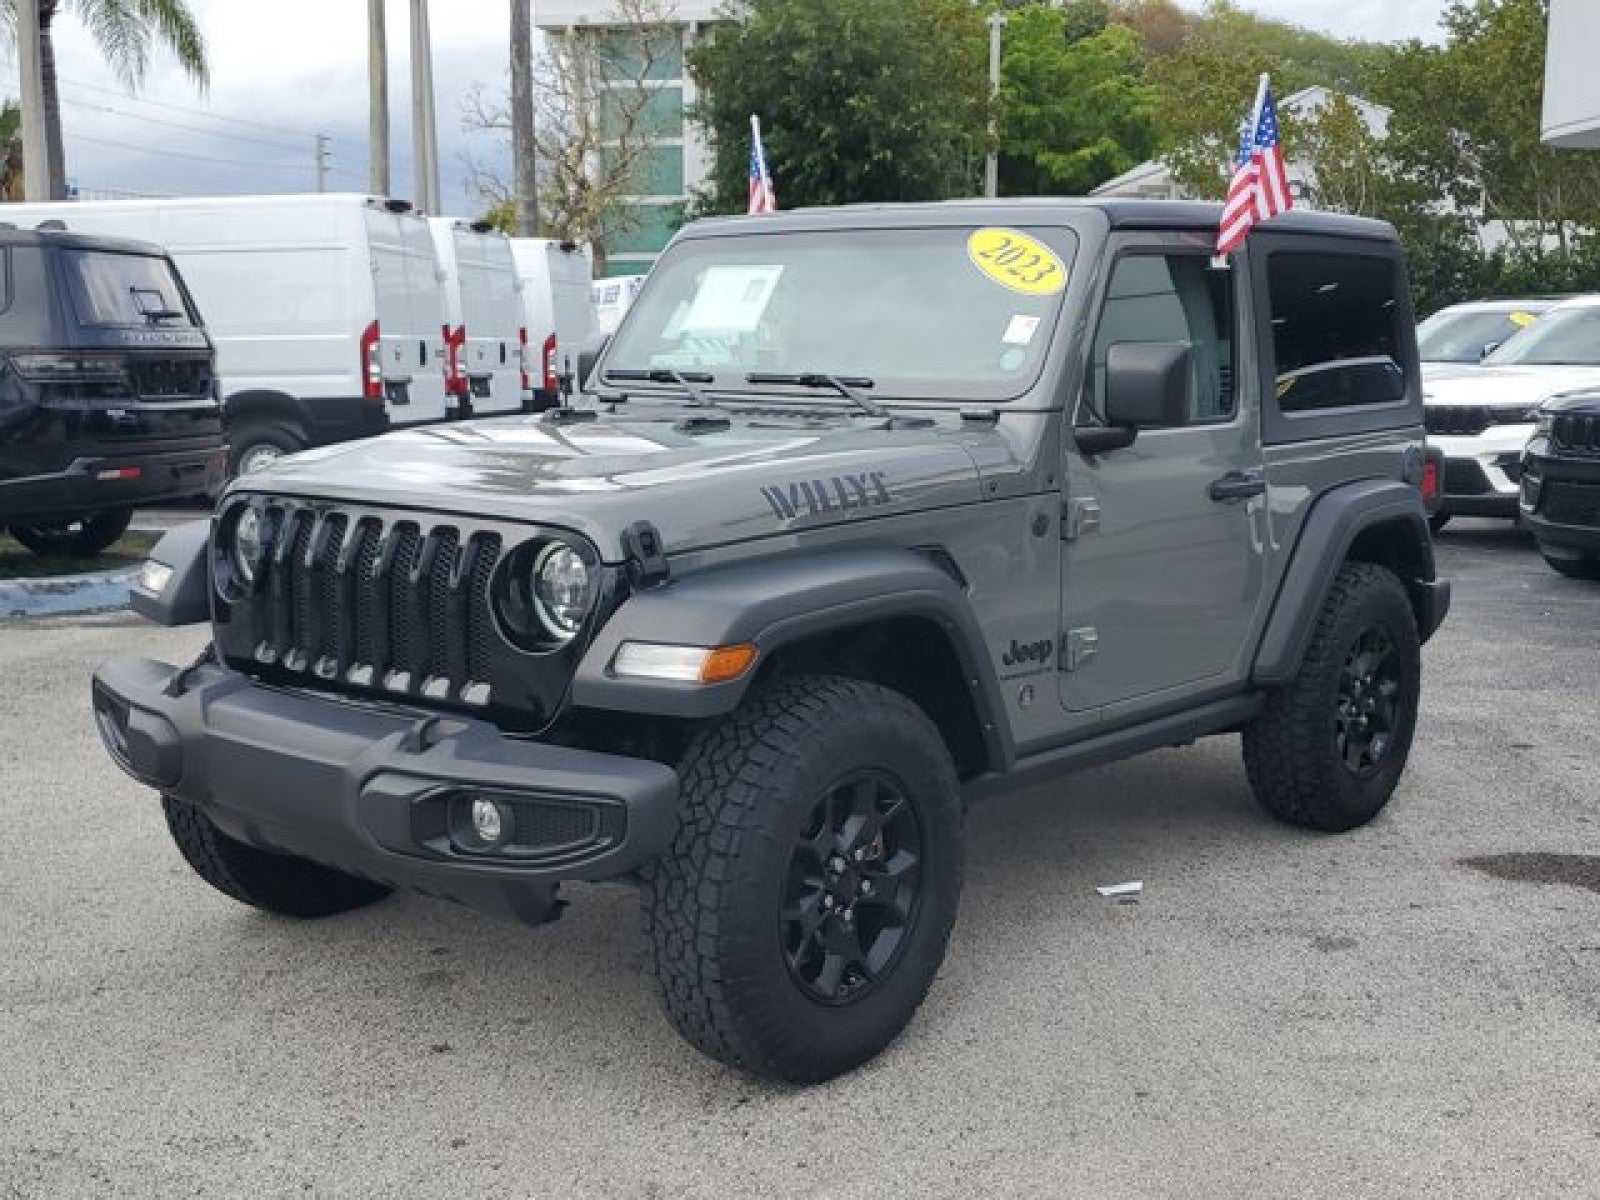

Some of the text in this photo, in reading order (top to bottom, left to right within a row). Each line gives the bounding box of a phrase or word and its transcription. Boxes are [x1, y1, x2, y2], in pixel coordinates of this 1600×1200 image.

[979, 237, 1056, 283] 2023
[759, 471, 890, 520] WILLYS
[1002, 638, 1053, 666] Jeep
